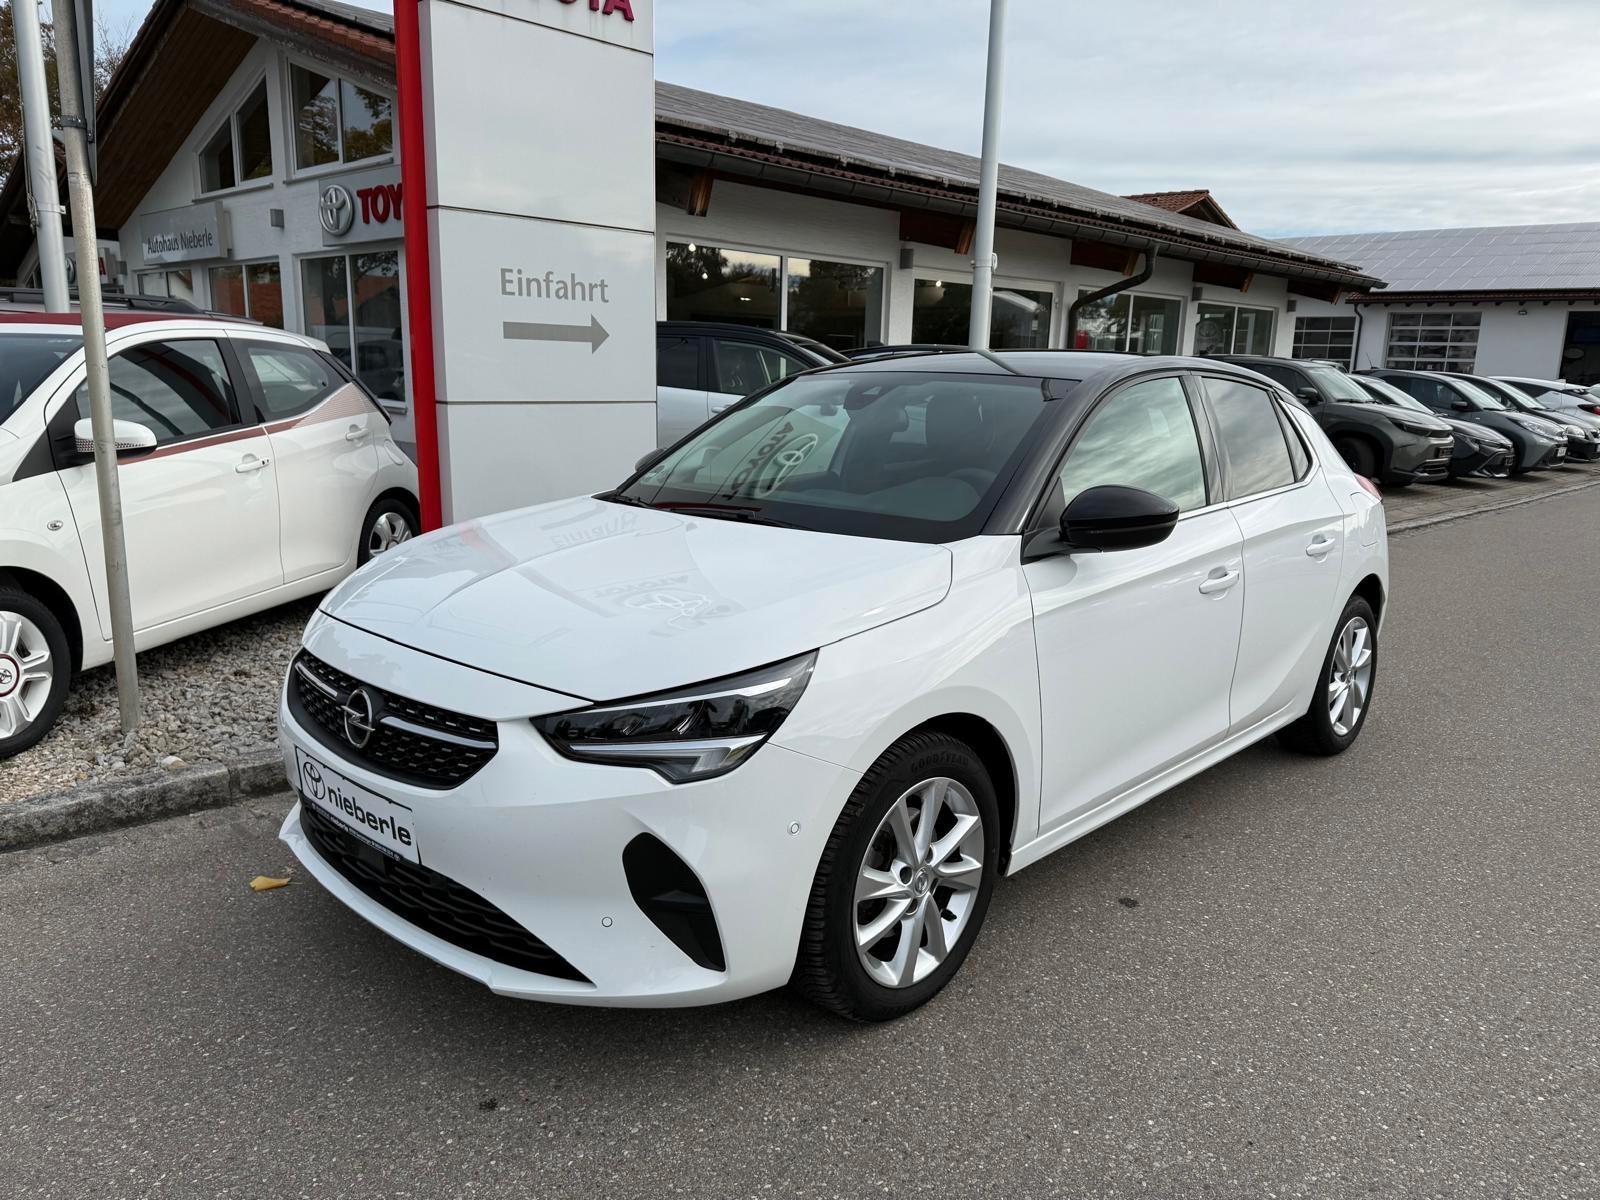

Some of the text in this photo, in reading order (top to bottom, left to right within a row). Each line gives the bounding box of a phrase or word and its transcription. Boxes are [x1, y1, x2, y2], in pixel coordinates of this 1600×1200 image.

[147, 227, 214, 254] Autohaus Nieberle
[500, 267, 609, 303] Einfahrt
[327, 786, 412, 846] nieberle
